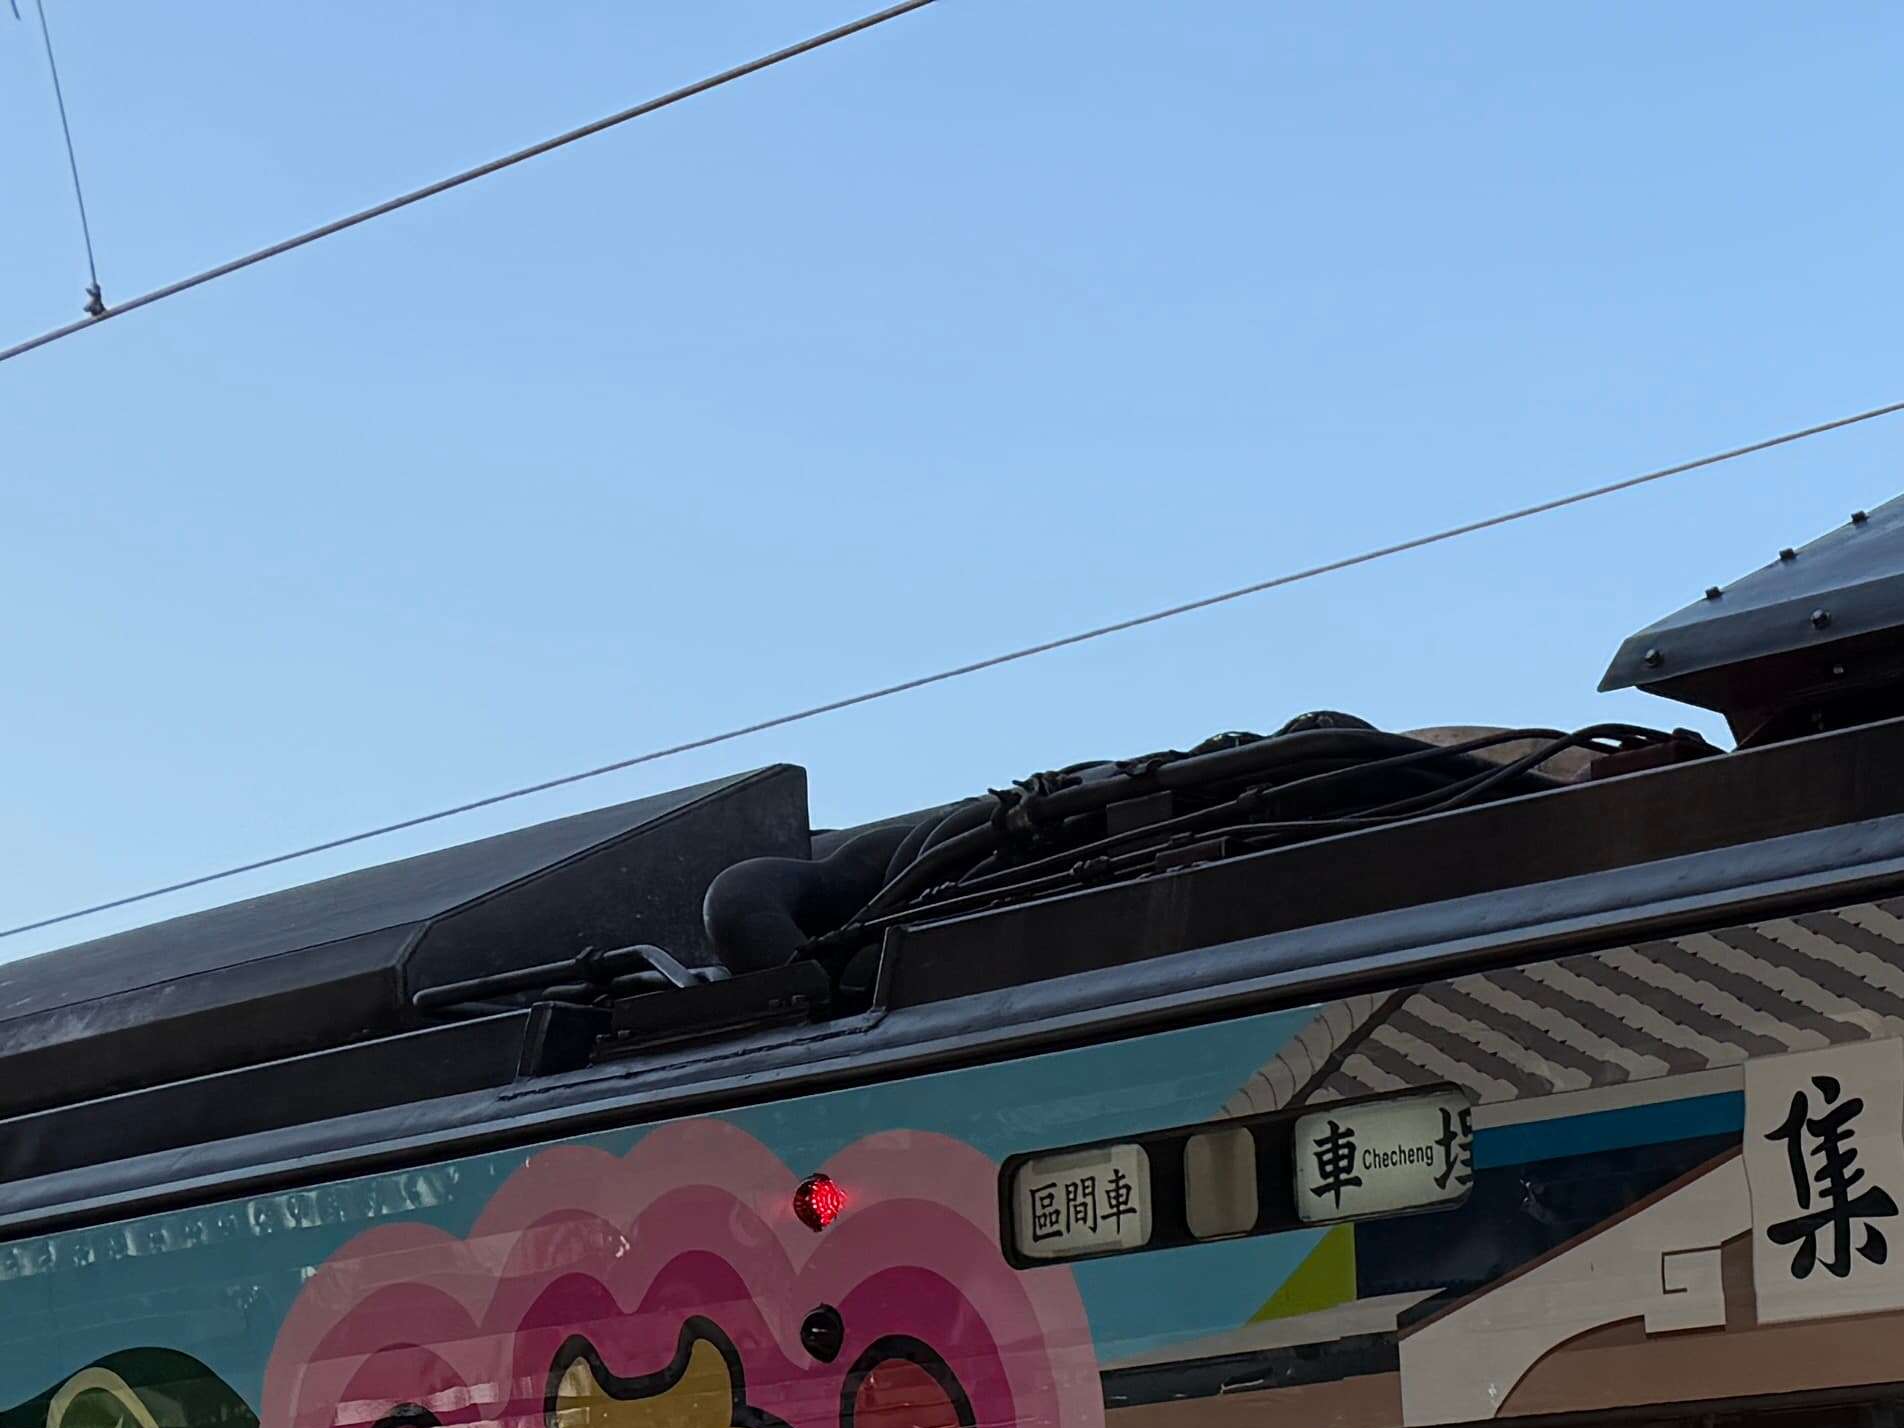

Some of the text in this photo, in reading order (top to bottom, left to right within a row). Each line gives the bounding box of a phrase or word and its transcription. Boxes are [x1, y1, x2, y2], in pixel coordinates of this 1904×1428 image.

[1310, 1119, 1363, 1210] 車
[1362, 1144, 1434, 1171] Checheng
[1029, 1169, 1138, 1243] 區間車
